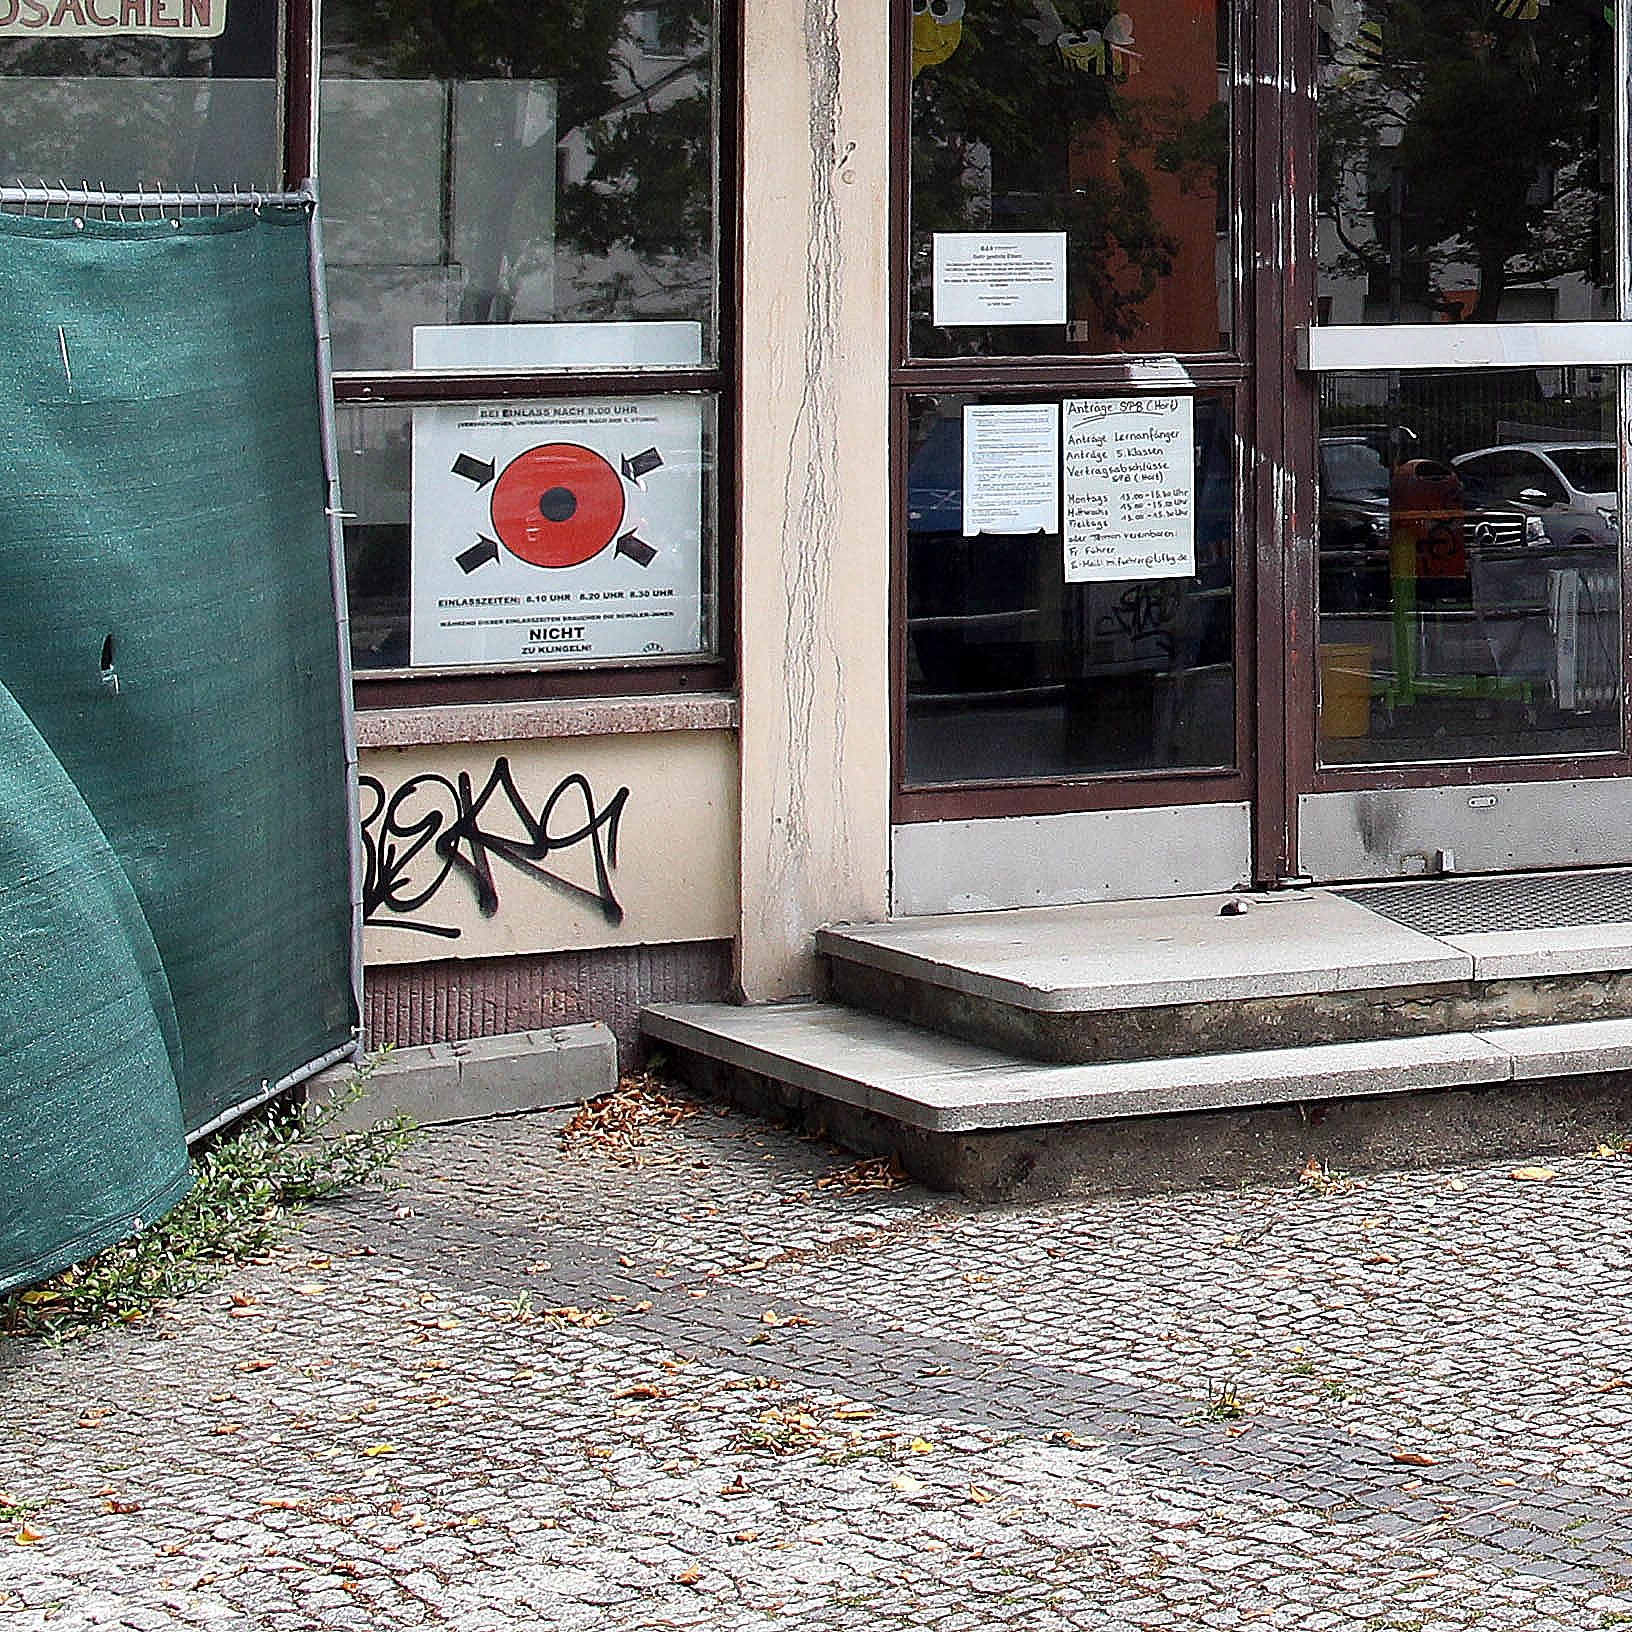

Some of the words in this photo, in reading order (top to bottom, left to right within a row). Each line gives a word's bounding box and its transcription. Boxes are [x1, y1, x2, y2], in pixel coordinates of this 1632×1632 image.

[549, 594, 571, 602] UHR
[603, 591, 625, 599] UHR
[652, 589, 673, 597] UHR
[529, 626, 585, 641] NICHT
[521, 647, 536, 655] ZU
[537, 644, 592, 654] KLINGELN!
